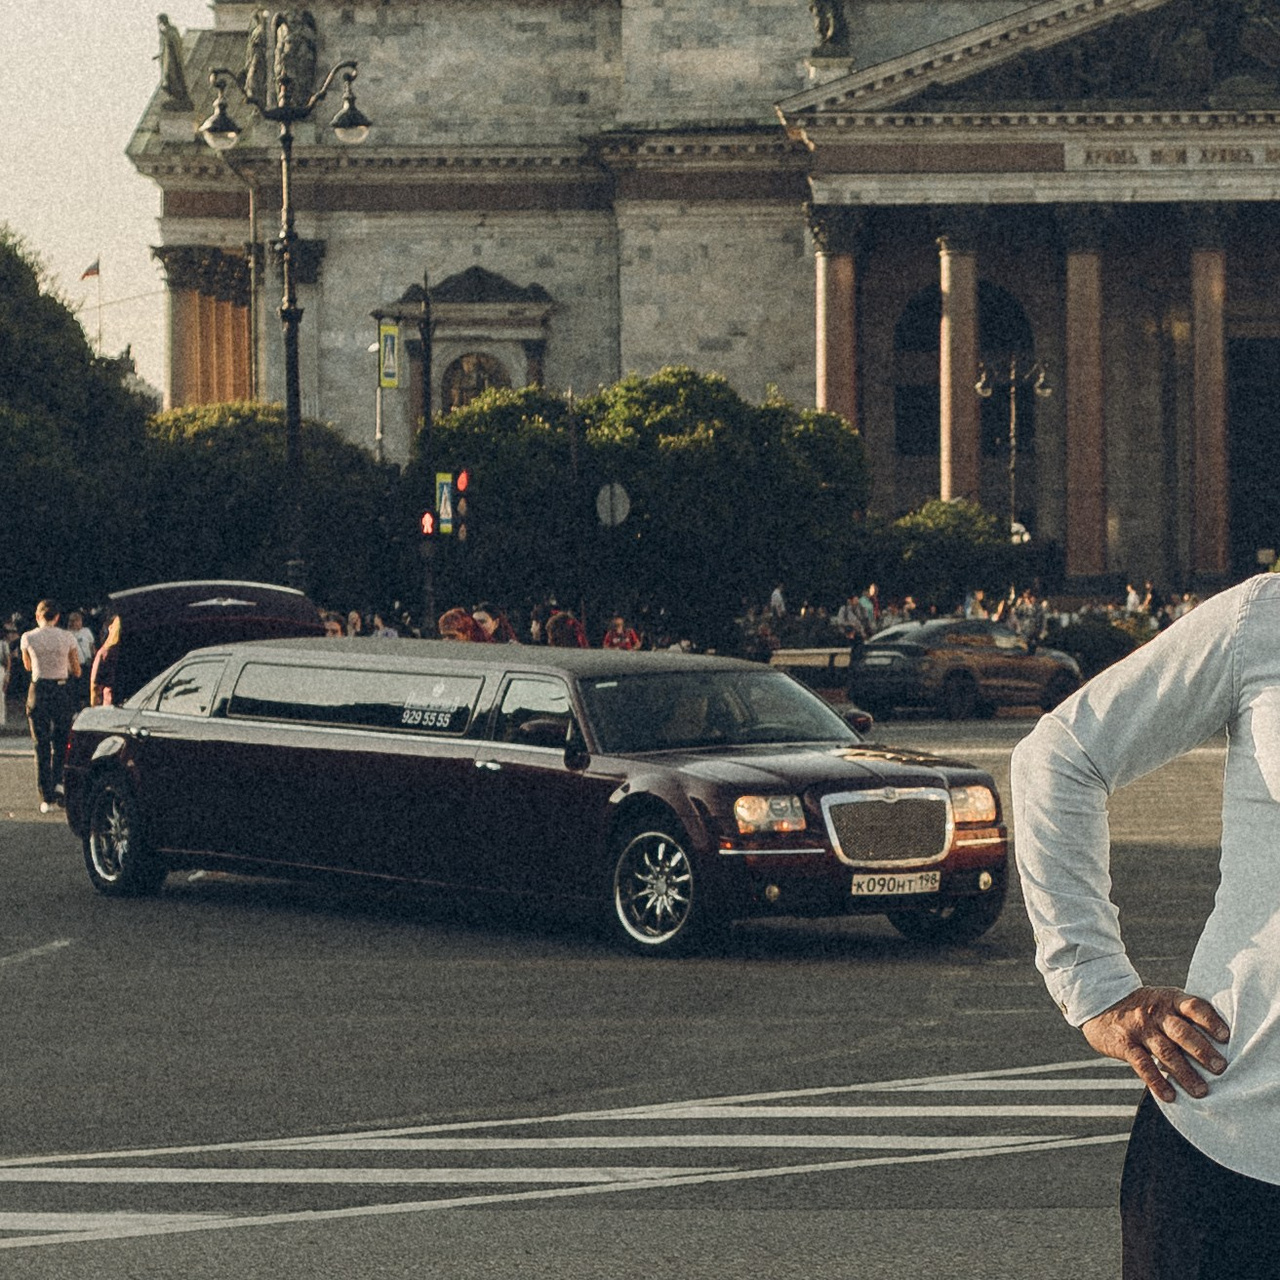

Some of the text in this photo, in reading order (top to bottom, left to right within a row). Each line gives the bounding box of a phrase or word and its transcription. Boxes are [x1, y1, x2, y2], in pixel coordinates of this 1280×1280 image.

[402, 710, 451, 727] 929 55 55
[856, 873, 937, 893] К090НТ 198
